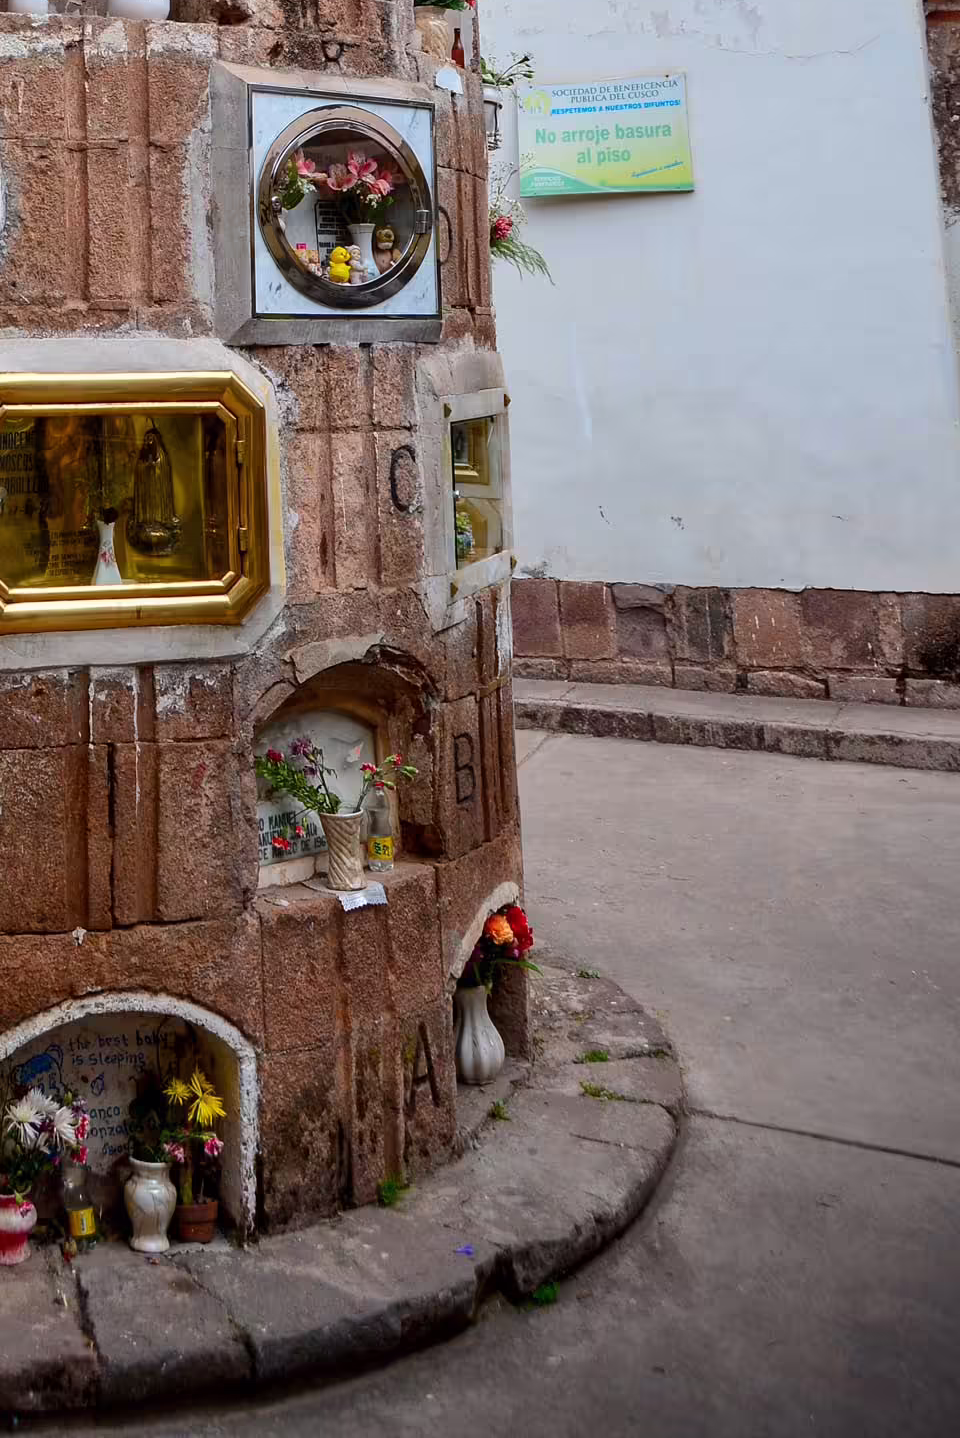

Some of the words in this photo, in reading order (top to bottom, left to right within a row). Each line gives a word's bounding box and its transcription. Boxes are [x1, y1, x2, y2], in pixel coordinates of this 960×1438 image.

[551, 86, 597, 98] SOCIEDAD
[599, 85, 612, 94] DE
[614, 79, 679, 93] BENEFICENCIA
[609, 92, 626, 101] DEL
[628, 89, 660, 99] CUSCO
[605, 103, 643, 112] NUESTROS
[535, 128, 557, 144] No
[561, 125, 610, 145] arroje
[615, 123, 672, 140] basura
[576, 148, 593, 164] al
[597, 146, 632, 166] piso
[453, 732, 477, 804] B
